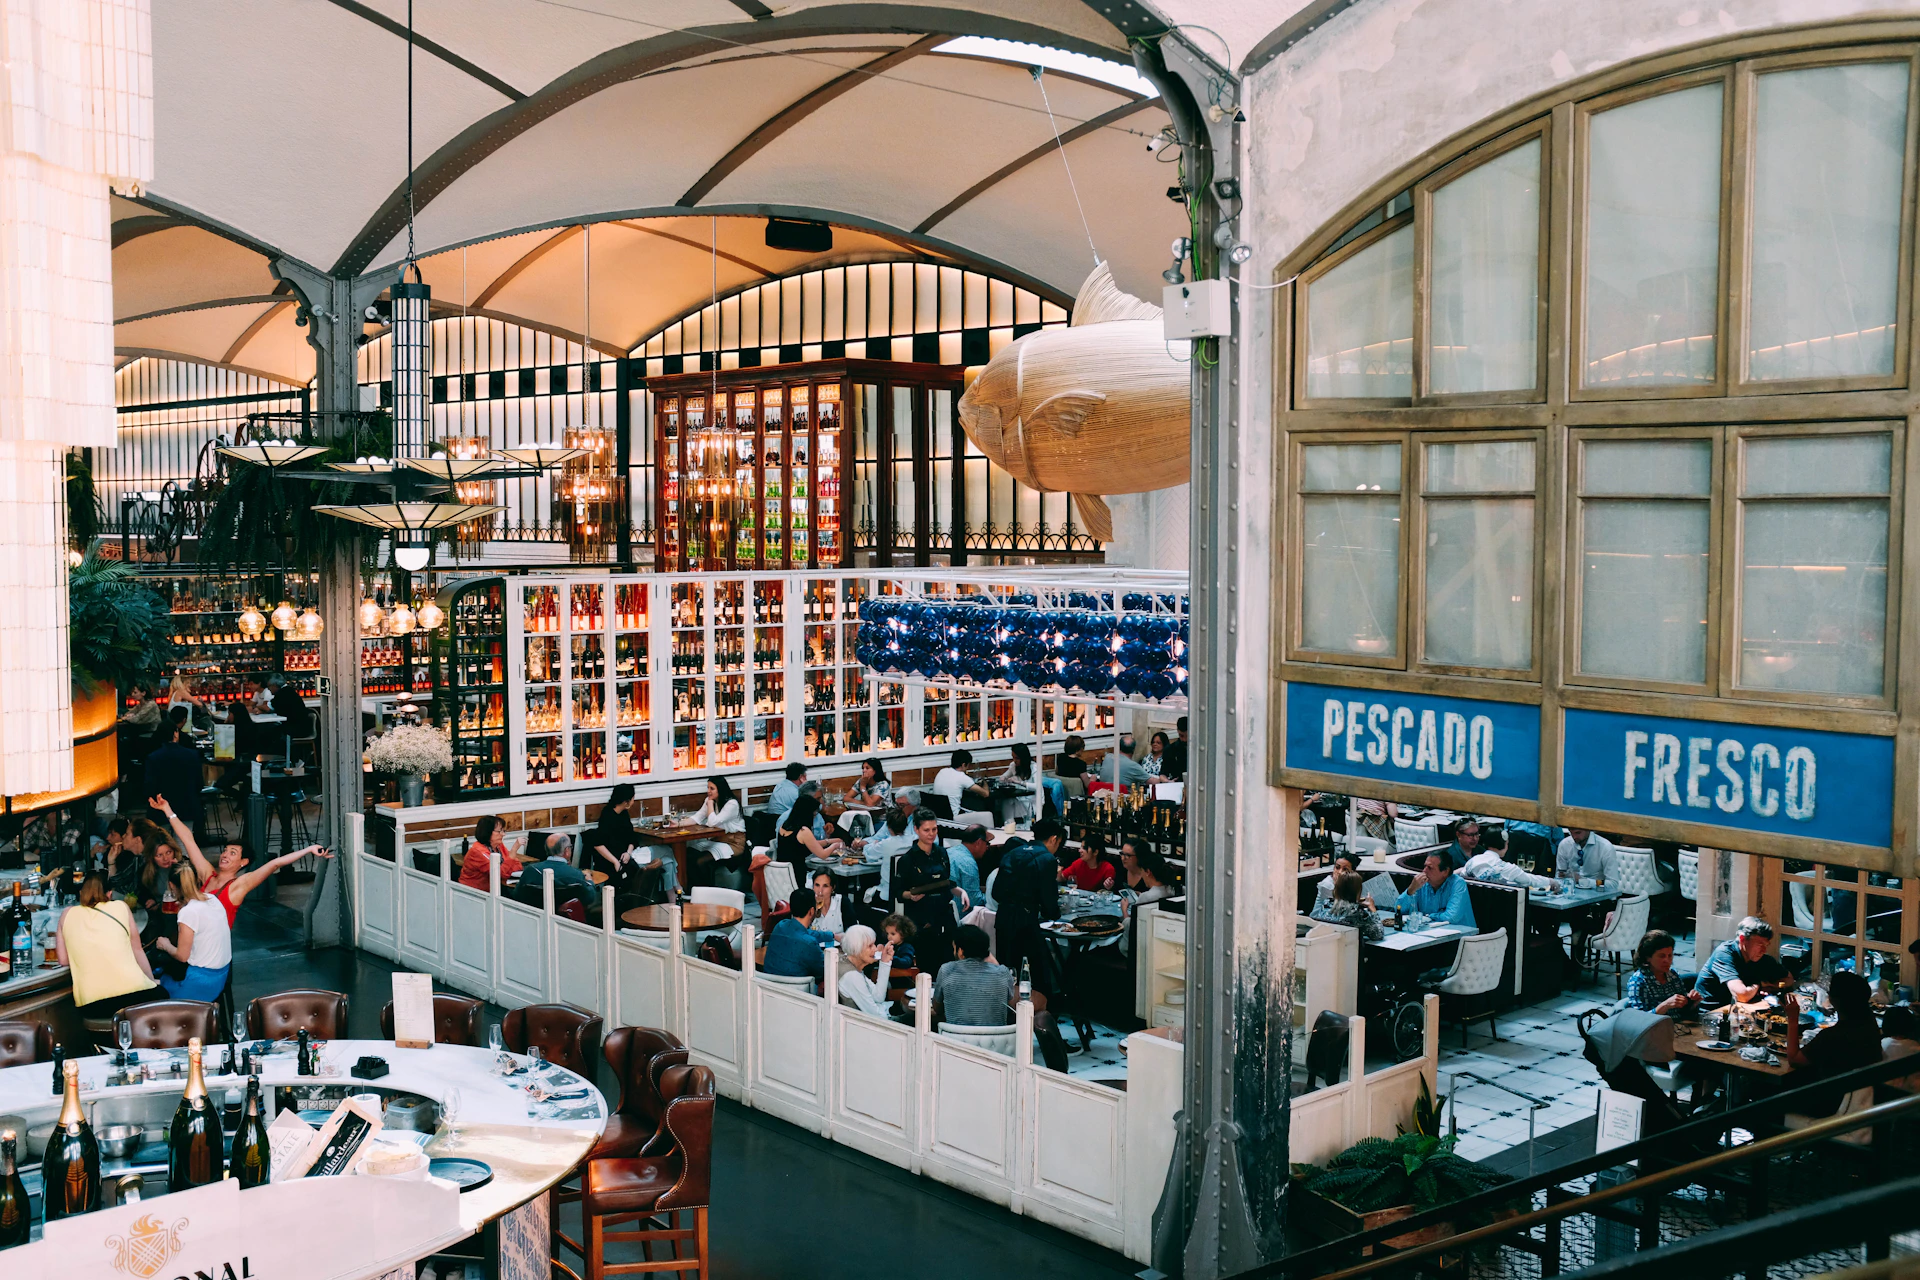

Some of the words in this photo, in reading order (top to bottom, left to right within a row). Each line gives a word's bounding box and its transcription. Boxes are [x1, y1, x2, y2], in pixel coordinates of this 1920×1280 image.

[1322, 698, 1494, 780] PESCADO
[1623, 730, 1817, 820] FRESCO
[320, 1127, 359, 1177] illardeau
